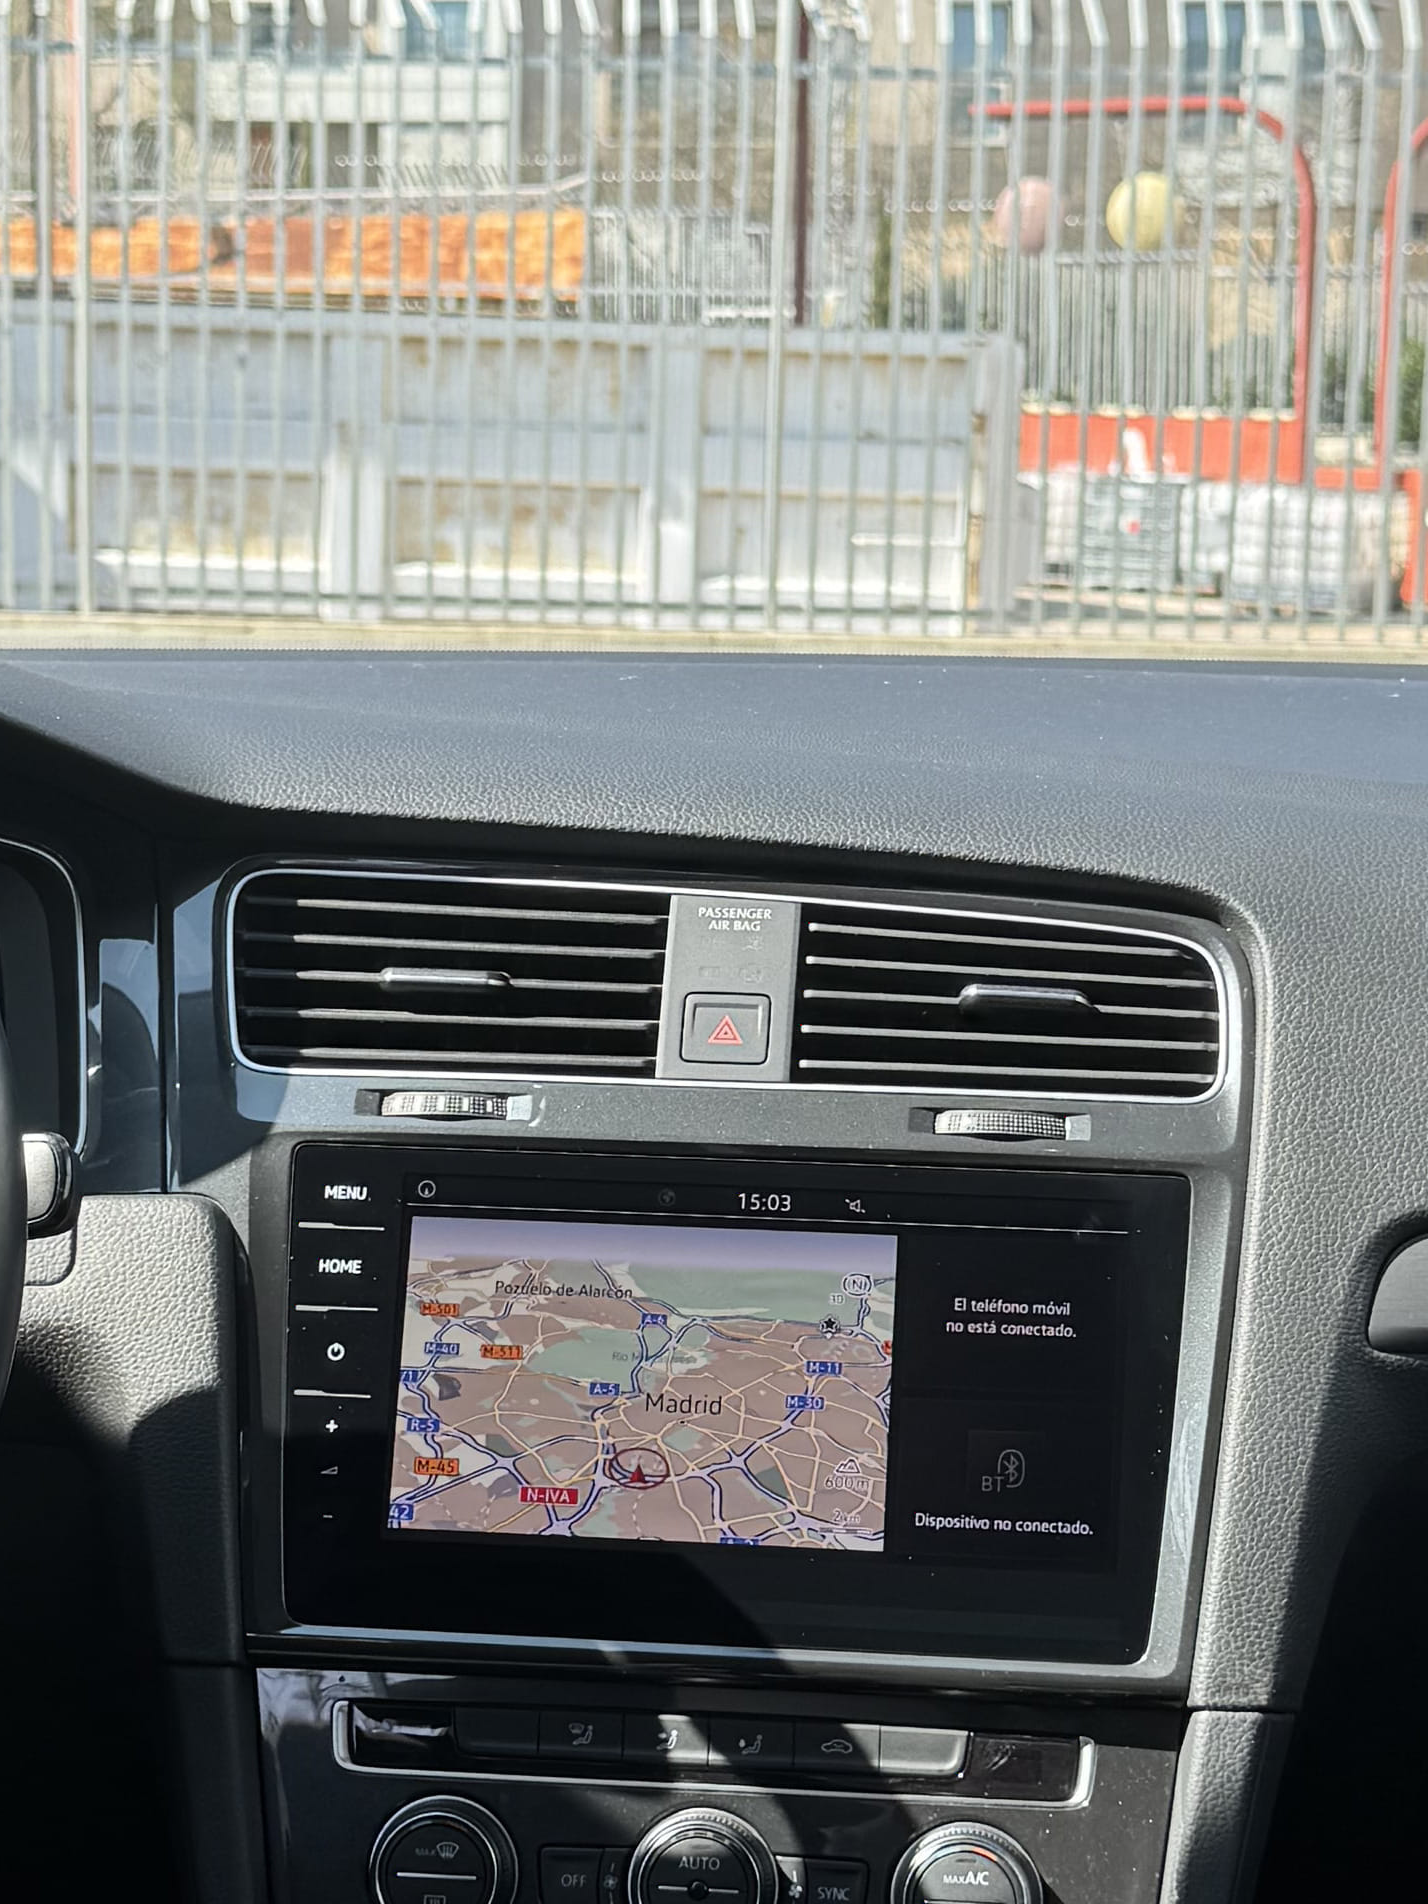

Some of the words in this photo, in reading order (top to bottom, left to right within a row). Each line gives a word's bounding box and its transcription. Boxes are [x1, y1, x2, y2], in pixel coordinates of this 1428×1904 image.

[698, 907, 772, 920] PASSENGER
[708, 920, 730, 931] AIR
[733, 920, 761, 932] BAG
[324, 1185, 369, 1200] MENU
[737, 1192, 792, 1211] 15:03
[318, 1259, 362, 1274] HOME
[495, 1280, 552, 1296] Pozuelo
[556, 1284, 573, 1297] de
[578, 1284, 633, 1299] Alarcón
[954, 1297, 966, 1311] El
[971, 1298, 1028, 1314] teléfono
[1032, 1301, 1071, 1316] móvil
[946, 1321, 963, 1332] no
[968, 1321, 996, 1334] está
[1001, 1323, 1077, 1338] conectado.
[594, 1385, 616, 1395] A-5
[646, 1393, 722, 1415] Madrid
[787, 1398, 822, 1409] M-30
[410, 1420, 435, 1431] R-5
[417, 1461, 455, 1474] M-45
[982, 1475, 1005, 1492] BT
[527, 1489, 570, 1503] N-IVA
[915, 1512, 990, 1530] Dispositivo
[994, 1520, 1012, 1531] no
[1016, 1520, 1093, 1536] conectado.
[678, 1856, 721, 1871] AUTO
[561, 1874, 587, 1887] OFF
[817, 1887, 851, 1900] SYNC
